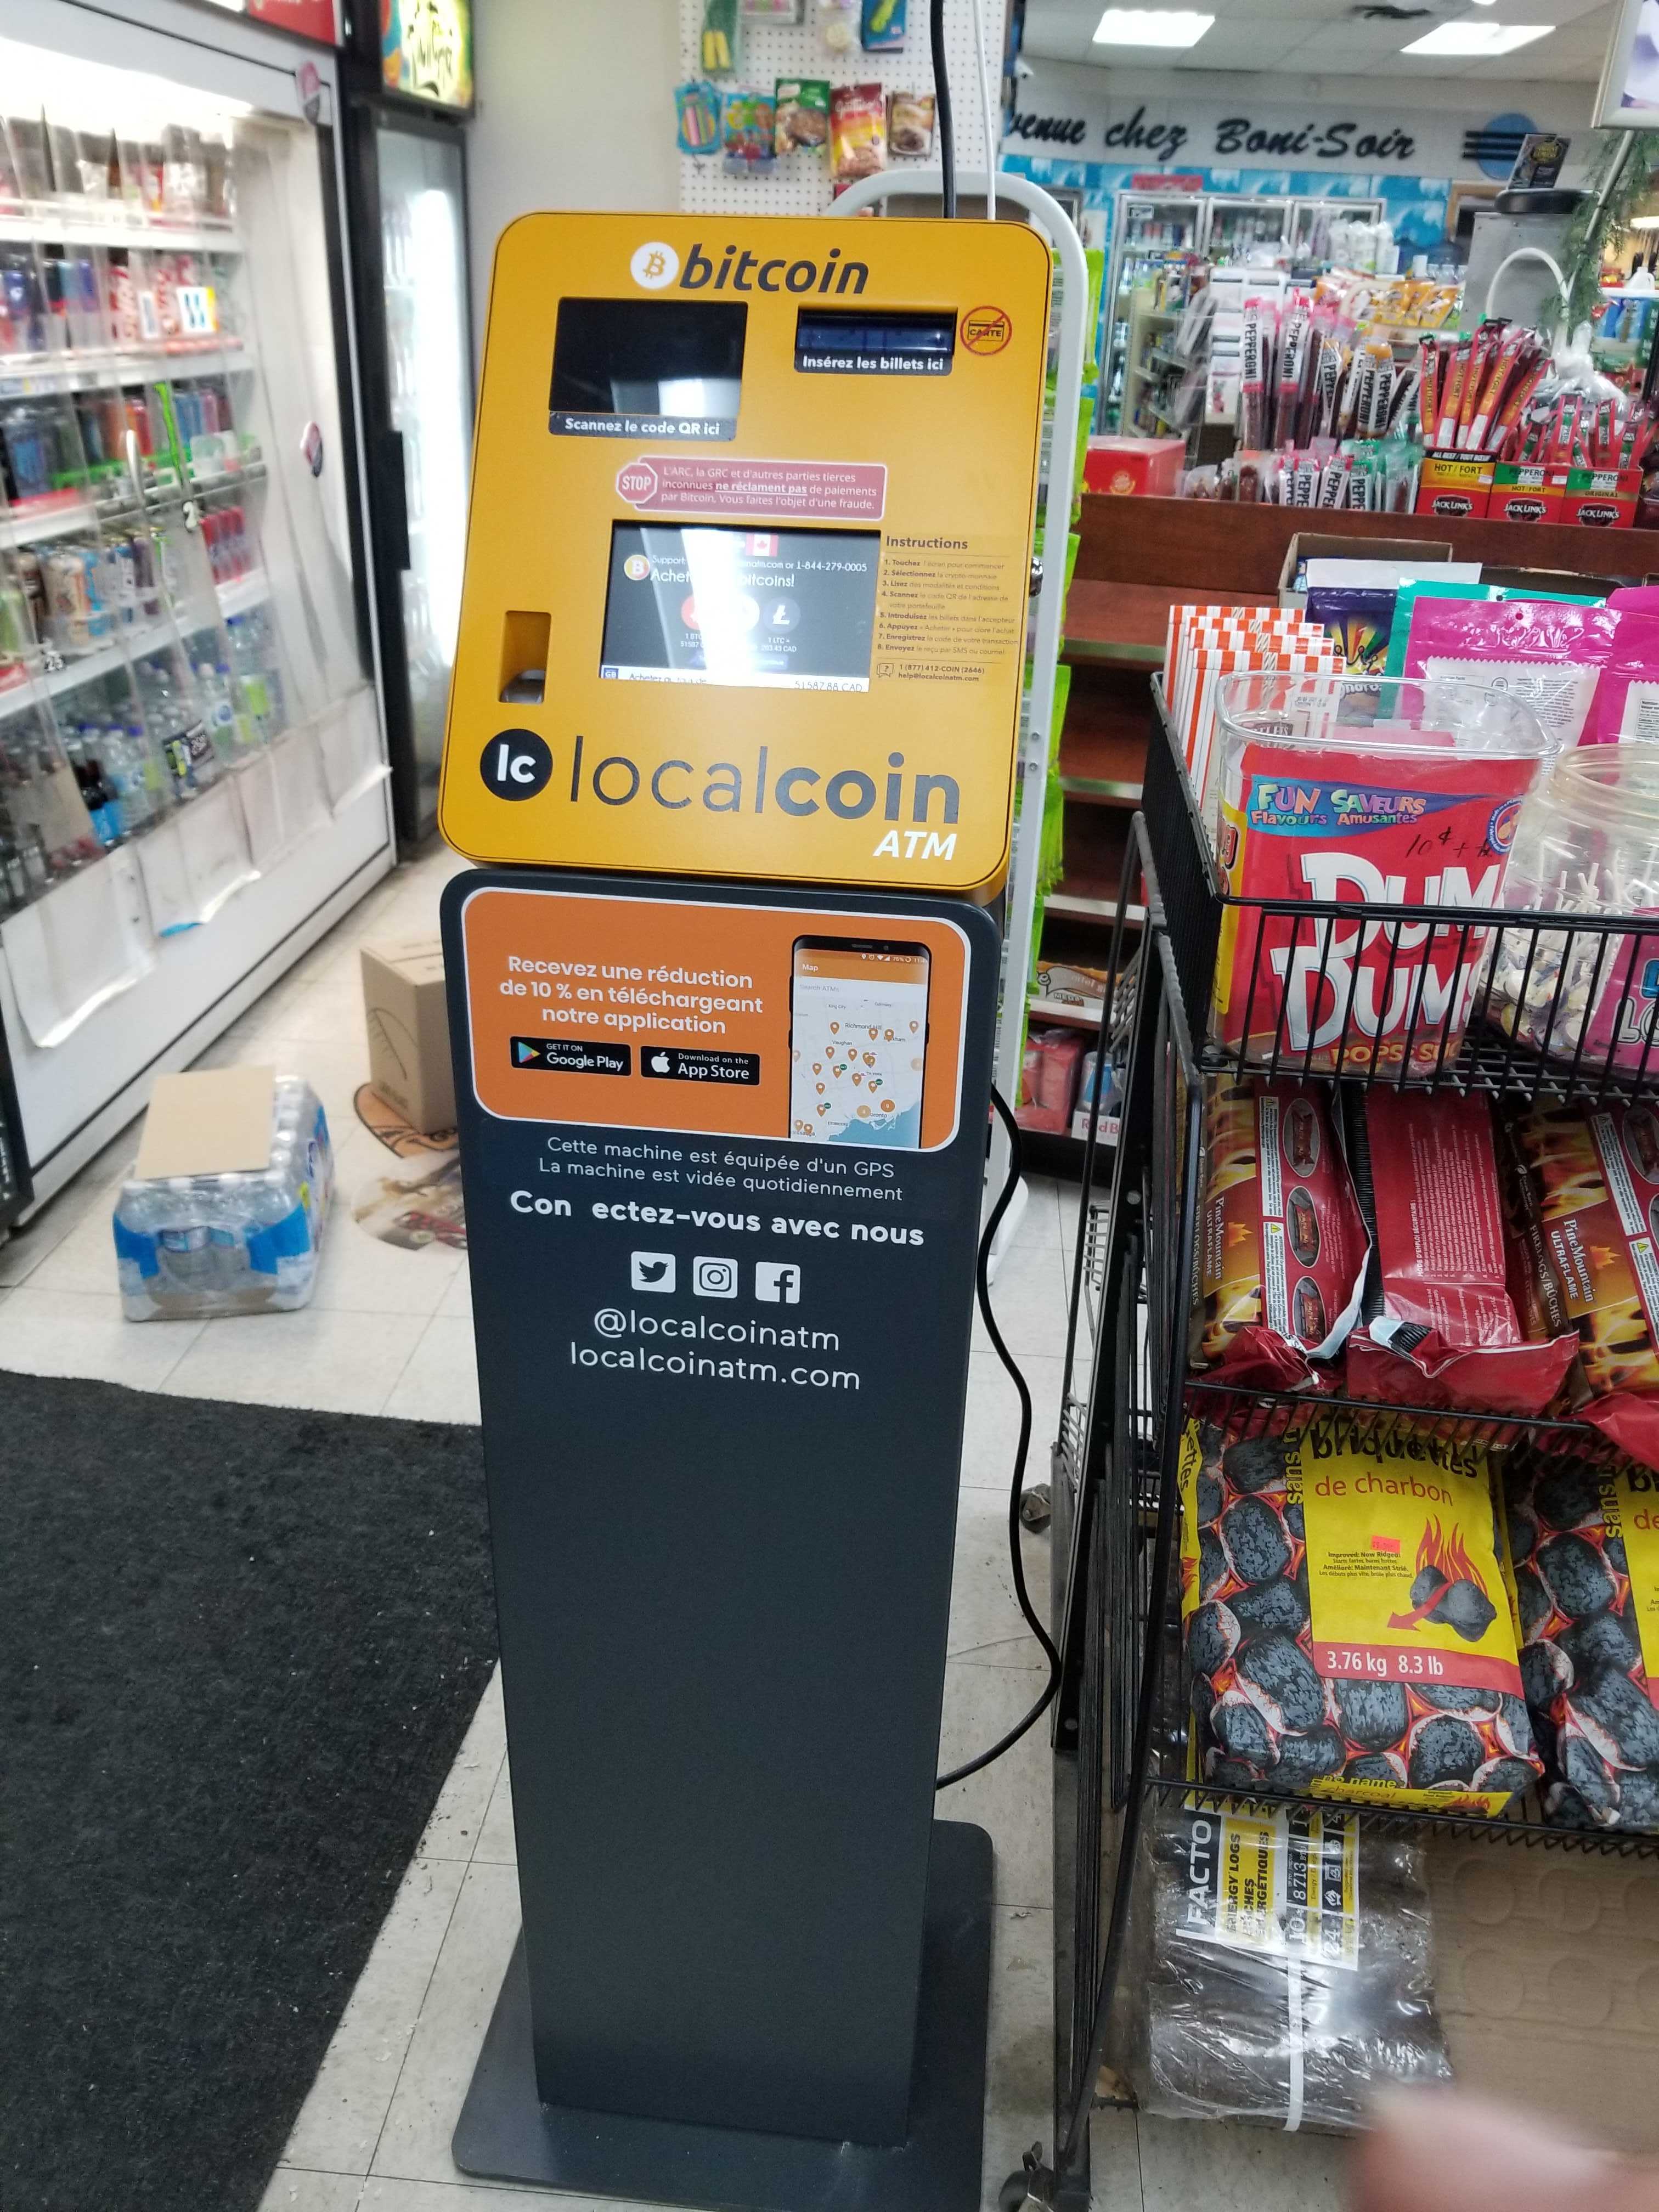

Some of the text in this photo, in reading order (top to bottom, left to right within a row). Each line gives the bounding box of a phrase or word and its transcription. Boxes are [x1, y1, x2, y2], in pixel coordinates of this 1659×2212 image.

[1104, 106, 1187, 161] chez
[1214, 119, 1417, 161] Boni-Soir
[679, 242, 870, 295] bitcoin
[803, 354, 944, 371] Insérez les billets ici
[565, 417, 720, 436] Scannez le code QR ici
[622, 474, 651, 491] STOP
[696, 467, 706, 477] la
[708, 468, 729, 478] GRC
[731, 470, 741, 479] et
[743, 469, 783, 481] d'autres
[786, 471, 821, 483] parties
[823, 472, 856, 483] tierces
[1434, 463, 1483, 475] HOT FORT
[661, 493, 678, 504] par
[719, 494, 743, 505] Vous
[746, 493, 774, 506] faites
[775, 495, 806, 509] l'objet
[809, 496, 837, 508] d'une
[663, 479, 713, 492] inconnues
[715, 482, 729, 492] ne
[731, 481, 786, 494] réclament
[788, 483, 808, 496] pas
[809, 484, 822, 495] de
[886, 535, 968, 550] Instructions
[797, 560, 867, 572] 1-844-279-0005
[887, 633, 926, 642] Enregistrez
[570, 735, 961, 825] localcoin
[1257, 783, 1427, 816] FUN SAVEURS
[1251, 810, 1418, 826] Flavours Amusantes
[874, 831, 957, 861] ATM
[508, 955, 754, 989] Recevez une réduction
[802, 963, 819, 972] Map
[499, 979, 764, 1016] de 10 % en téléchargeant
[542, 1007, 726, 1037] notre application
[546, 1052, 624, 1073] Google Play
[678, 1052, 718, 1063] Download
[735, 1056, 749, 1065] the
[678, 1063, 750, 1081] App Store
[548, 1137, 895, 1179] Cette machine est équipée d'un GPS
[539, 1157, 904, 1202] La machine est vidée quotidiennement
[510, 1189, 572, 1217] Con
[771, 1217, 840, 1239] avec
[851, 1223, 926, 1246] nous
[1205, 1209, 1214, 1278] ULTRAFLAME
[1550, 1229, 1579, 1300] ULTRAFLAME
[592, 1307, 840, 1351] @localcoinatm
[570, 1341, 862, 1390] localcoinatm.com
[1314, 1471, 1454, 1506] de charbon
[1326, 1650, 1444, 1677] 3.76 kg 8.3 lb
[1349, 1777, 1398, 1788] name
[1228, 1833, 1240, 1872] LOGS
[1187, 1820, 1212, 1926] FACTO
[1293, 1862, 1307, 1900] 8713
